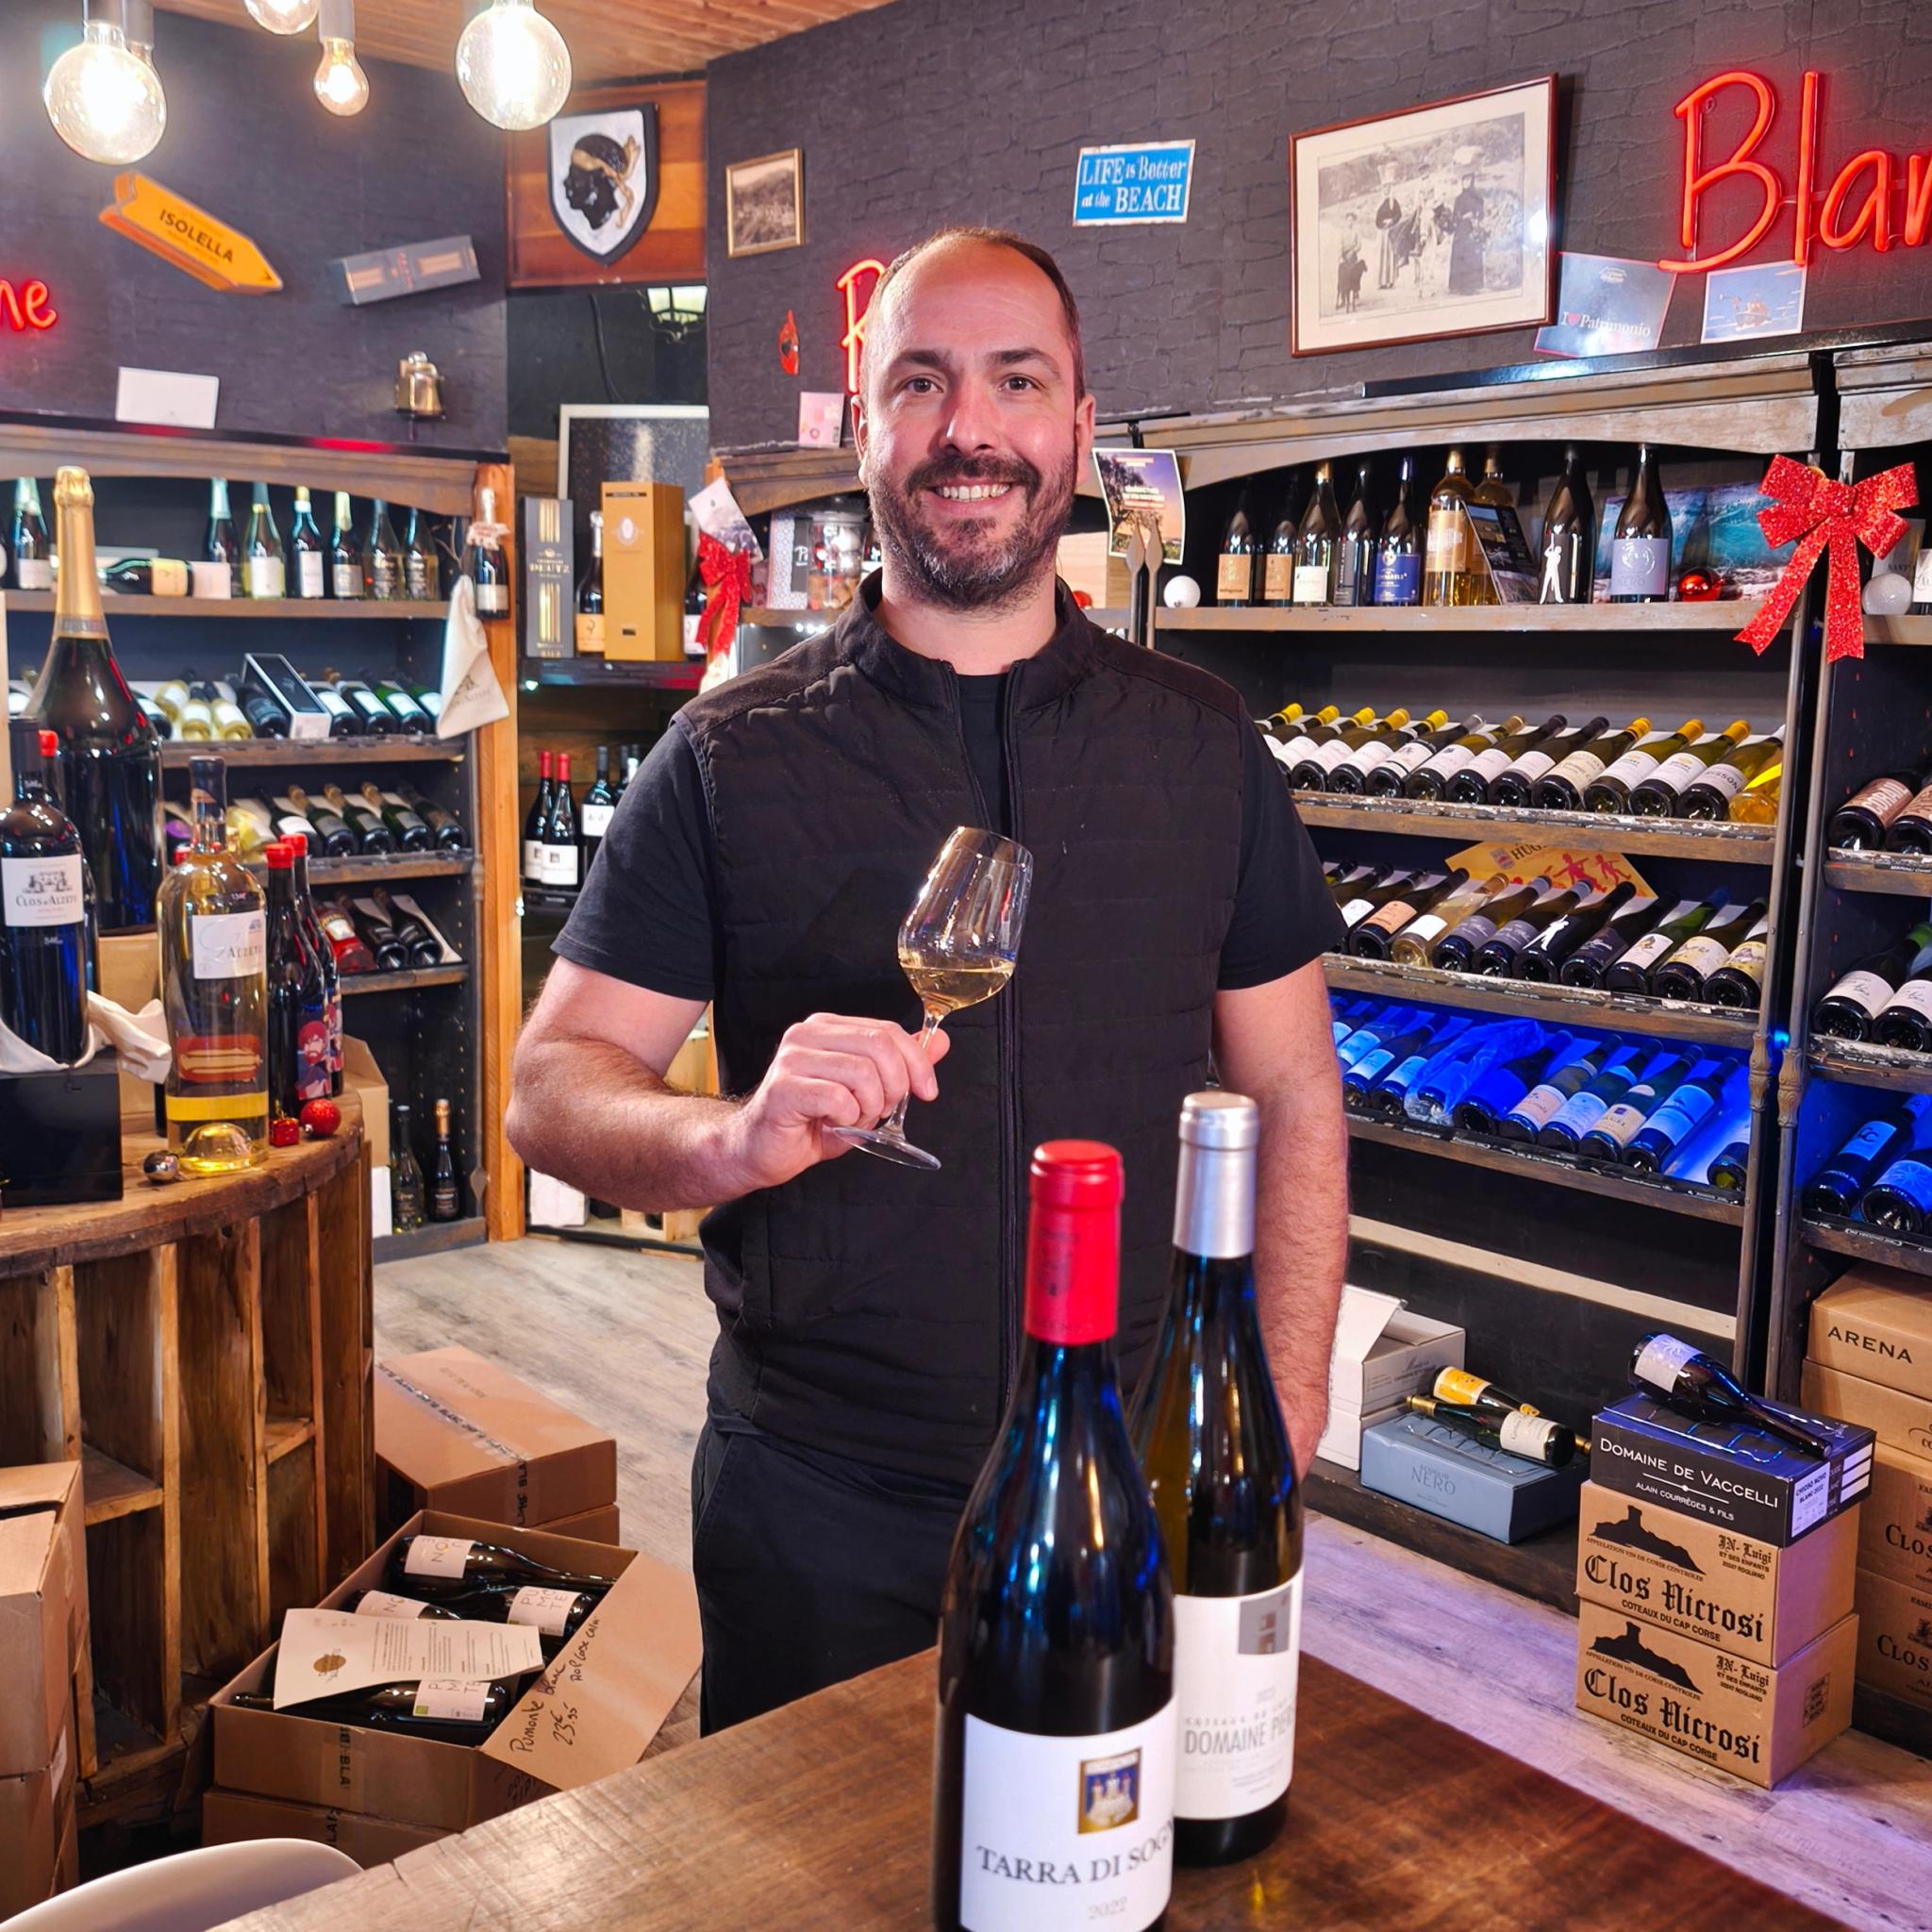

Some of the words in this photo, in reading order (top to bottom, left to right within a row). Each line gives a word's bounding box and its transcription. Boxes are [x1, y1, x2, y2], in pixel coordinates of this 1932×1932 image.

[1080, 158, 1125, 186] LIFE
[1125, 163, 1137, 179] is
[1138, 155, 1187, 181] Better
[1081, 192, 1094, 208] at
[1094, 190, 1111, 208] the
[1114, 183, 1183, 214] BEACH
[158, 208, 235, 263] ISOLELLA
[1562, 310, 1569, 325] I
[1579, 314, 1651, 338] Patrimonio
[1861, 780, 1909, 816] CORAIL
[1511, 842, 1548, 860] HUG
[1827, 1325, 1913, 1364] ARENA
[1411, 1466, 1456, 1496] NERO
[1600, 1438, 1668, 1473] DOMAINE
[1674, 1464, 1695, 1481] DE
[1699, 1470, 1779, 1509] VACCELLI
[1635, 1482, 1659, 1496] ALAIN
[1659, 1489, 1707, 1512] COURRÈGES
[1708, 1506, 1716, 1515] &
[1716, 1507, 1735, 1521] FILS
[1587, 1537, 1624, 1555] APPELLATION
[1743, 1542, 1772, 1565] Luigi
[1741, 1558, 1770, 1573] ENFANTS
[1585, 1554, 1651, 1600] Clos
[1662, 1578, 1764, 1642] Nicrosi
[1622, 1598, 1658, 1620] COTEAUX
[1659, 1612, 1673, 1624] DU
[1673, 1617, 1691, 1631] CAP
[1691, 1624, 1722, 1642] CORSE
[1586, 1650, 1624, 1670] APPELLATION
[1876, 1634, 1929, 1672] CLOS
[1739, 1679, 1767, 1695] ENFANTS
[1740, 1664, 1770, 1688] Luigi
[509, 1700, 545, 1753] Pumonte
[541, 1663, 566, 1696] blanc
[1584, 1667, 1650, 1716] Clos
[1659, 1696, 1760, 1764] Nicrosi
[1184, 1722, 1266, 1756] DOMAINE
[1620, 1712, 1657, 1734] COTEAUX
[1657, 1727, 1670, 1740] DU
[1670, 1732, 1689, 1748] CAP
[1689, 1742, 1719, 1761] CORSE
[975, 1844, 1082, 1885] TARRA
[1089, 1854, 1121, 1882] DI
[1125, 1817, 1174, 1872] SOG
